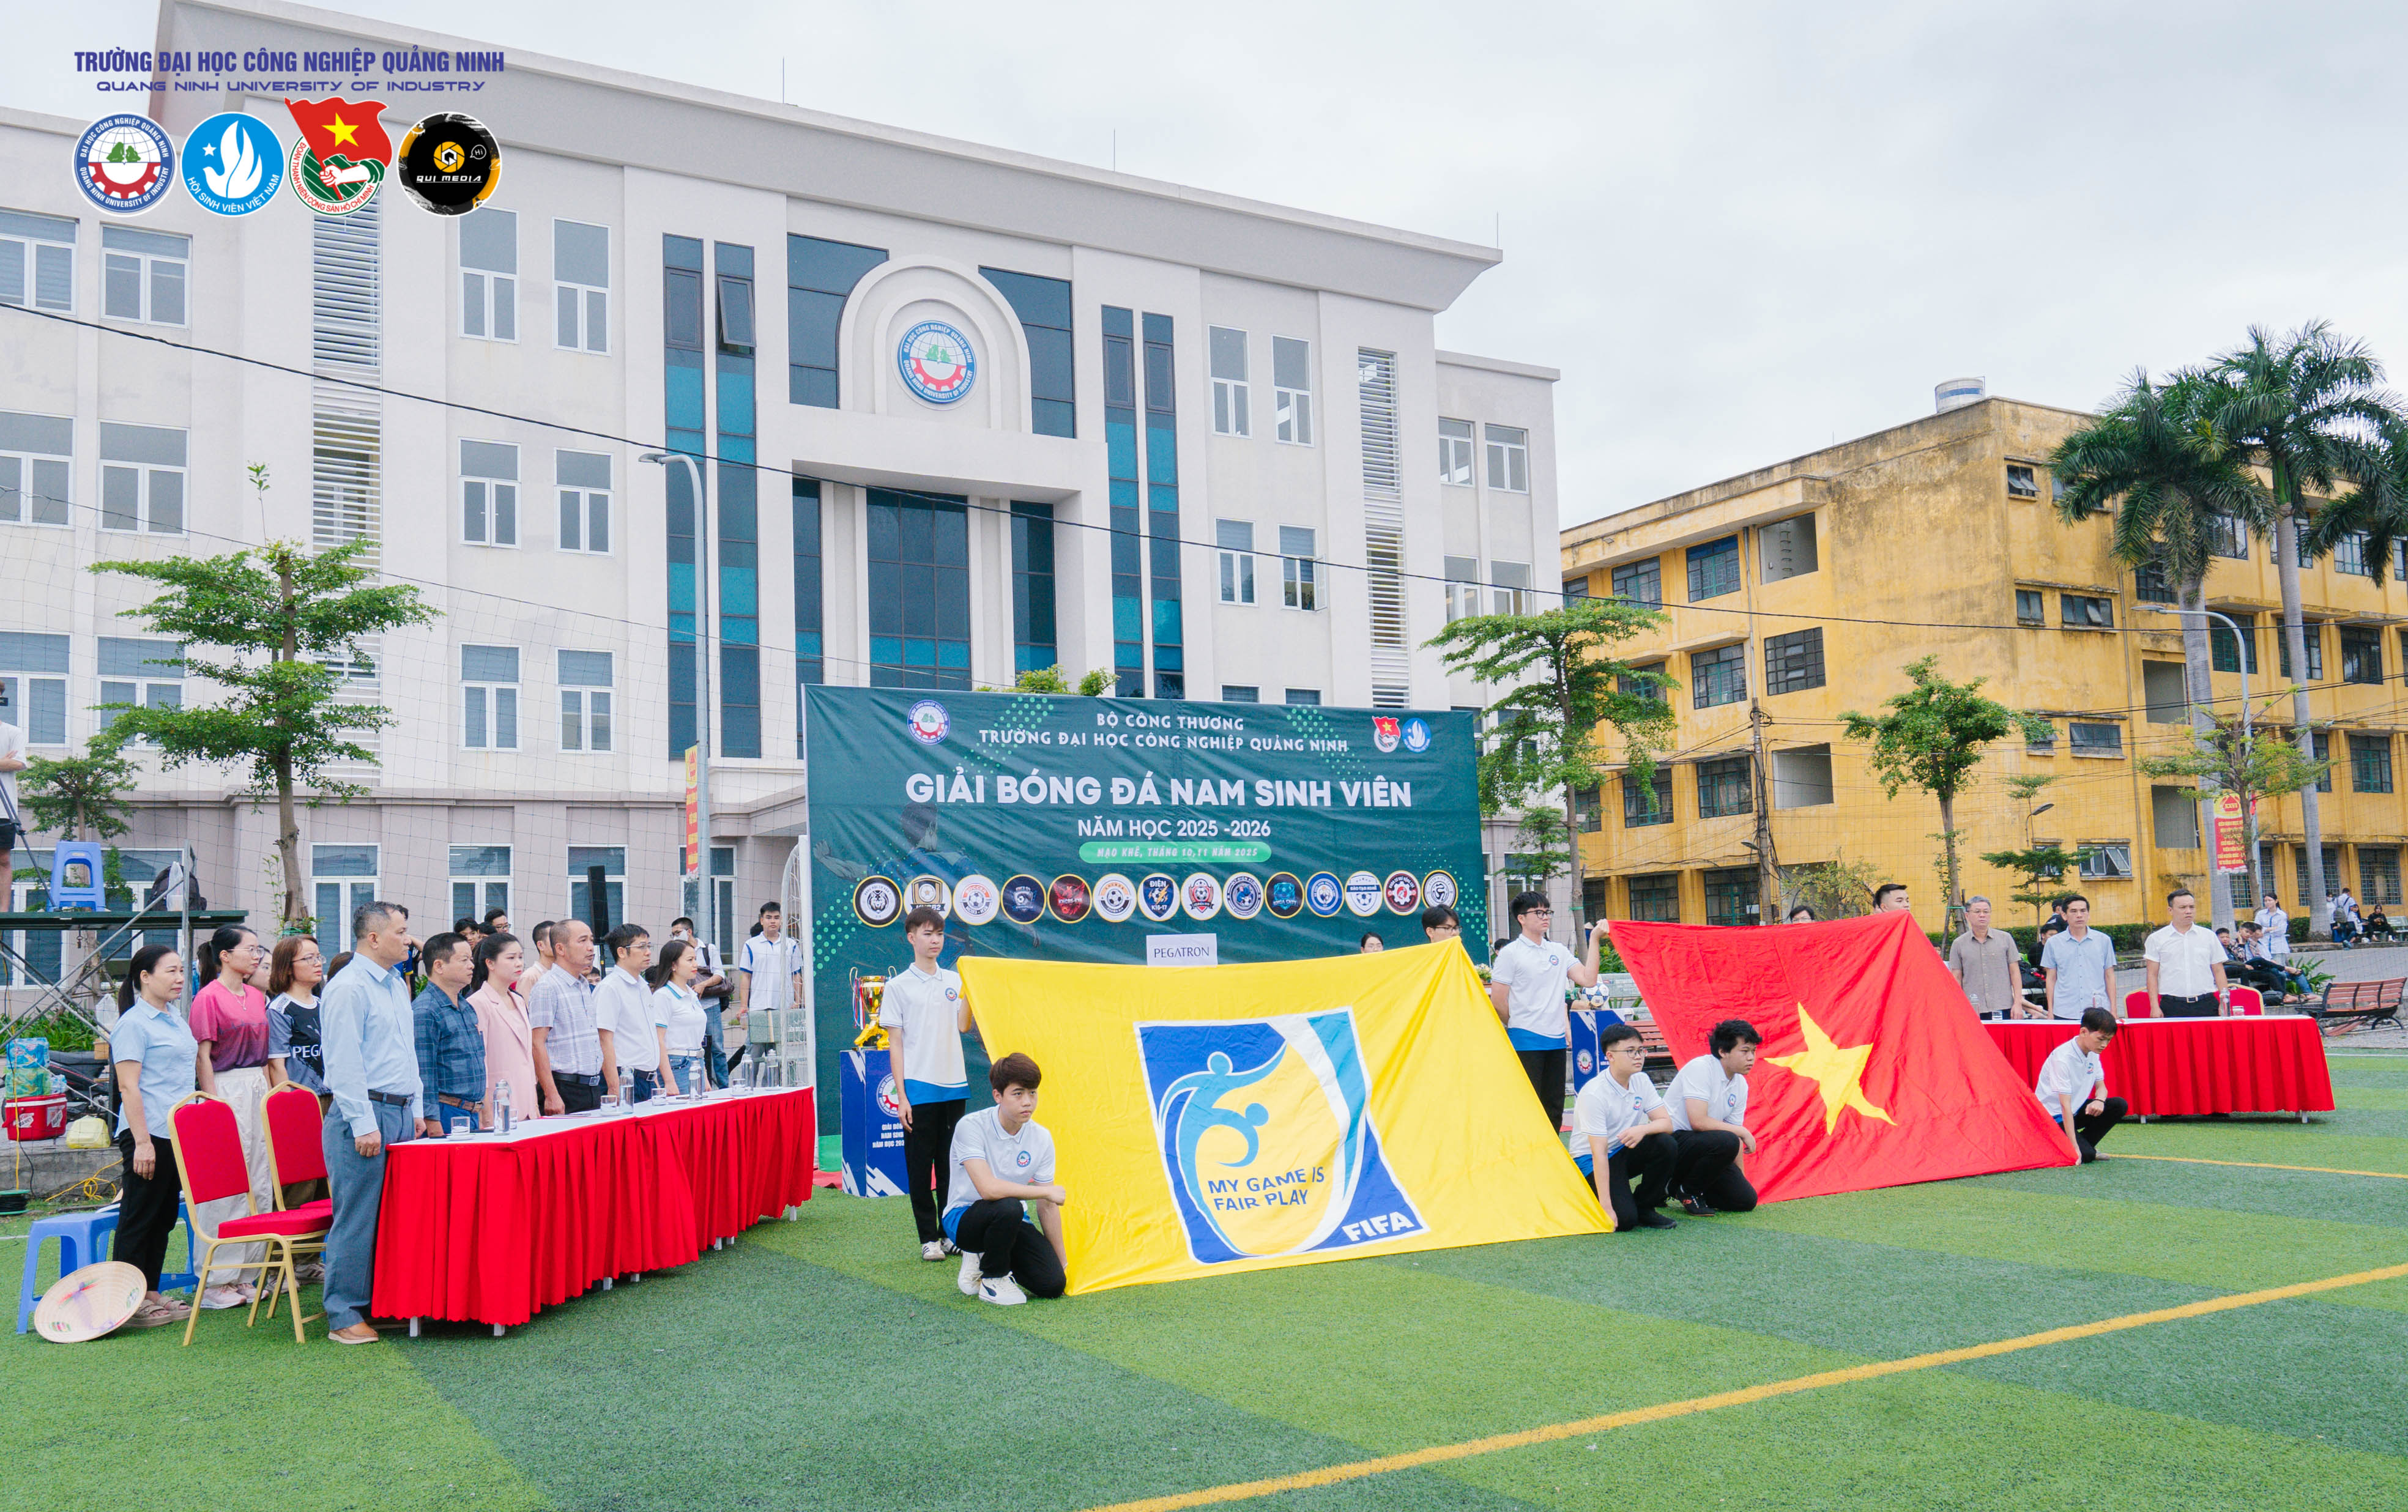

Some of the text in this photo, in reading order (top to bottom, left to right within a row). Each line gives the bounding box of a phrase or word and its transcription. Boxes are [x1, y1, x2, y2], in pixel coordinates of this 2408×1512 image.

[1096, 710, 1244, 731] BỘ CÔNG THƯƠNG
[979, 728, 1348, 752] TRƯỜNG ĐẠI HỌC CÔNG NGHIỆP QUẢNG NINH
[905, 766, 1411, 807] GIẢI BÓNG ĐÁ NAM SINH VIÊN
[1078, 815, 1271, 840] NĂM HỌC 2025 -2026
[1097, 845, 1258, 858] MẠO KHÊ, THÁNG 10,11 NĂM 2025
[1154, 946, 1209, 958] PEGATRON
[1208, 1166, 1325, 1193] MY GAME IS
[1213, 1189, 1308, 1211] FAIR PLAY
[1342, 1211, 1415, 1242] FIFA
